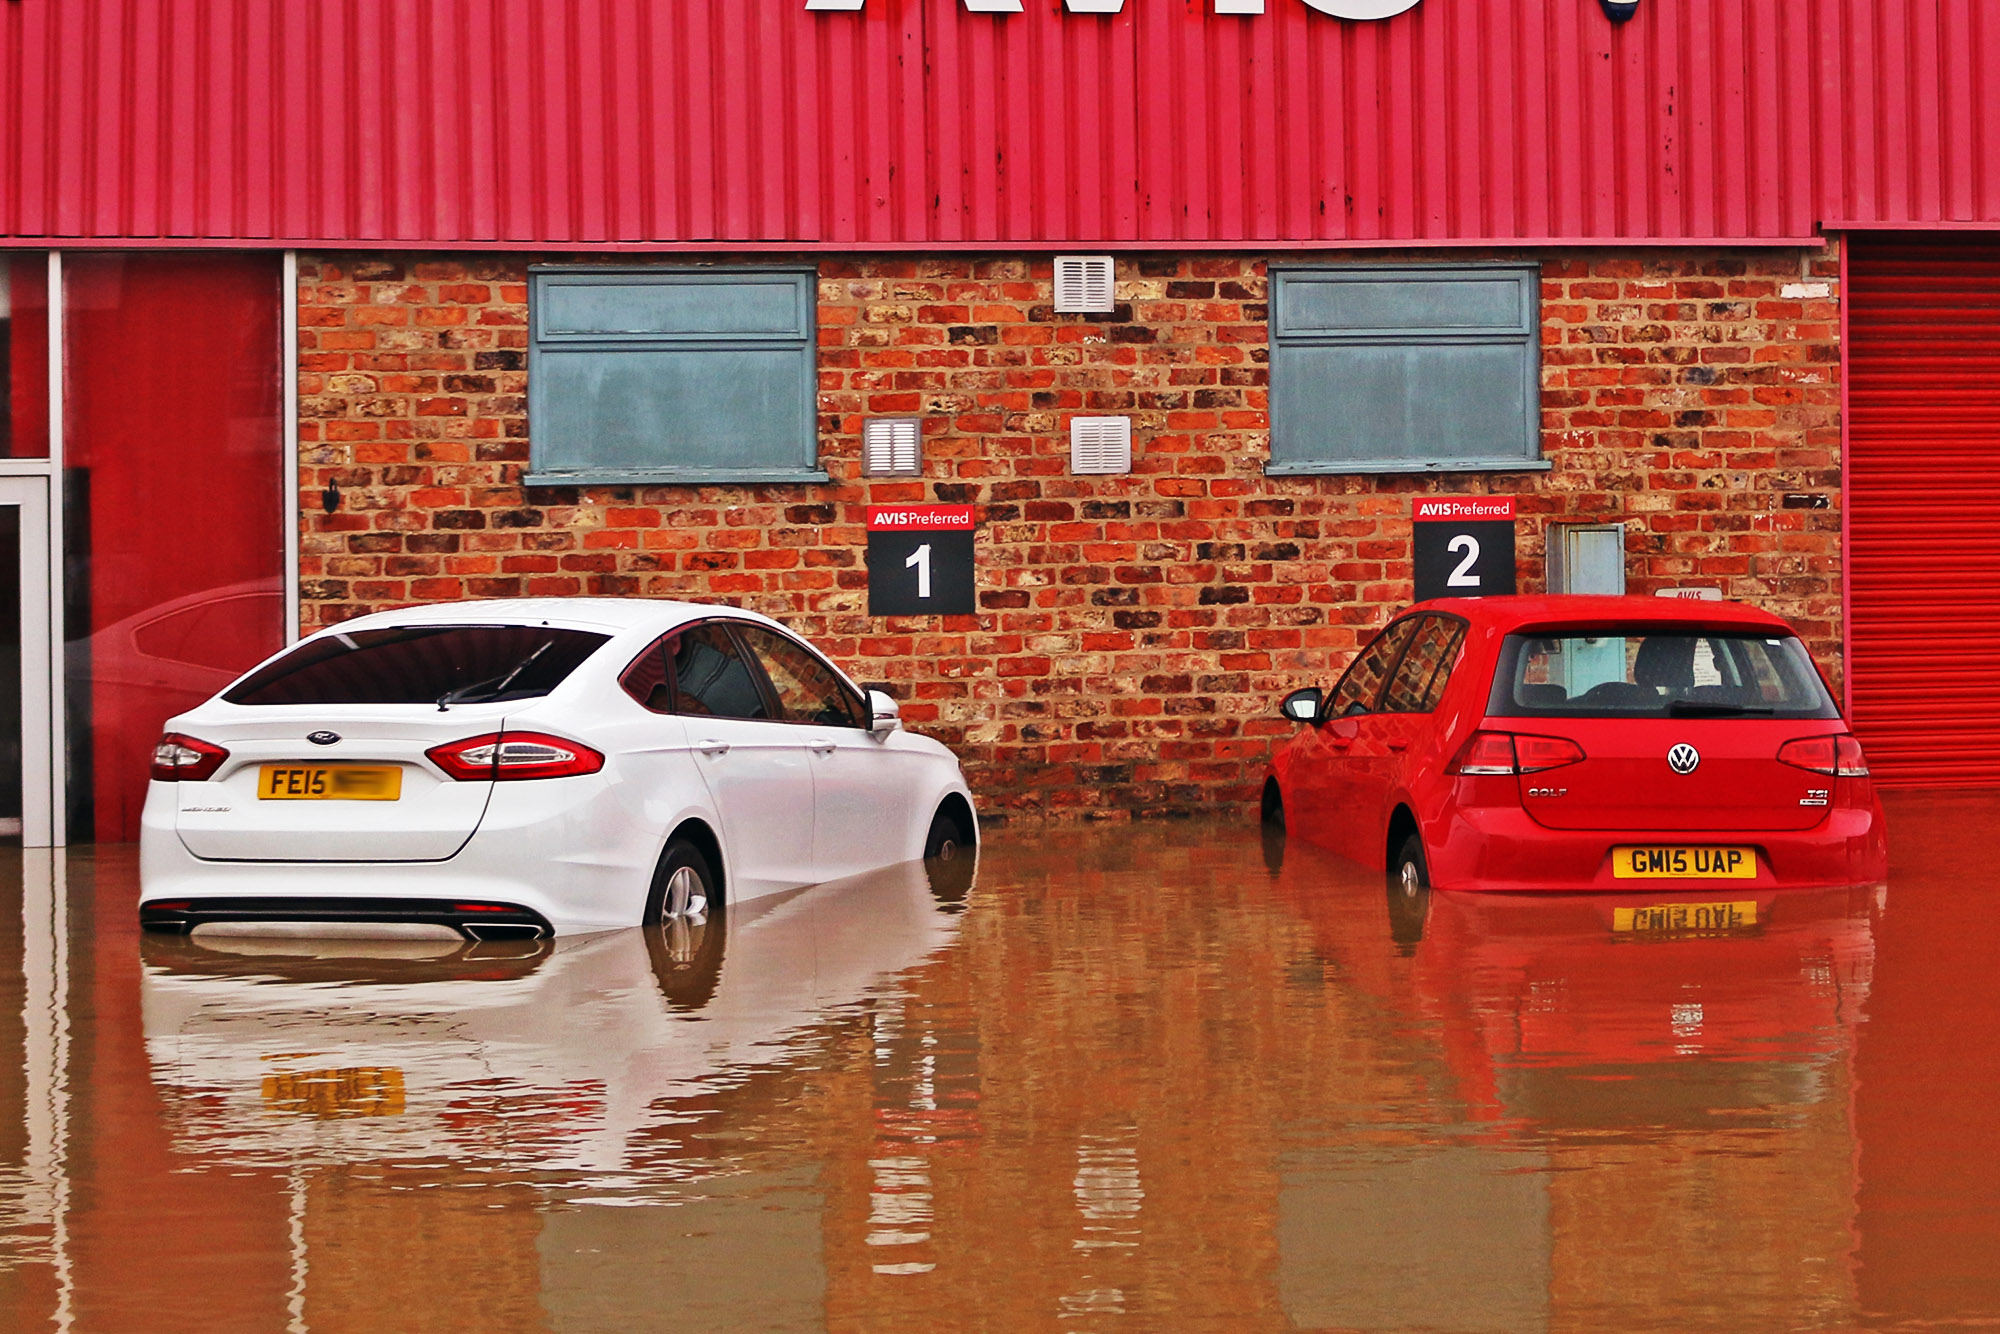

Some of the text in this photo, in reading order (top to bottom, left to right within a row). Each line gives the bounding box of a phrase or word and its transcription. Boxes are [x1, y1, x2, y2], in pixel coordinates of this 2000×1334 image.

[873, 511, 969, 525] AVIS Preferred
[1419, 502, 1510, 516] AVIS Preferred
[905, 543, 932, 598] 1
[1446, 534, 1481, 588] 2
[270, 769, 327, 795] FE15
[1528, 788, 1567, 797] GOLF
[1631, 850, 1743, 873] GM15 UAP
